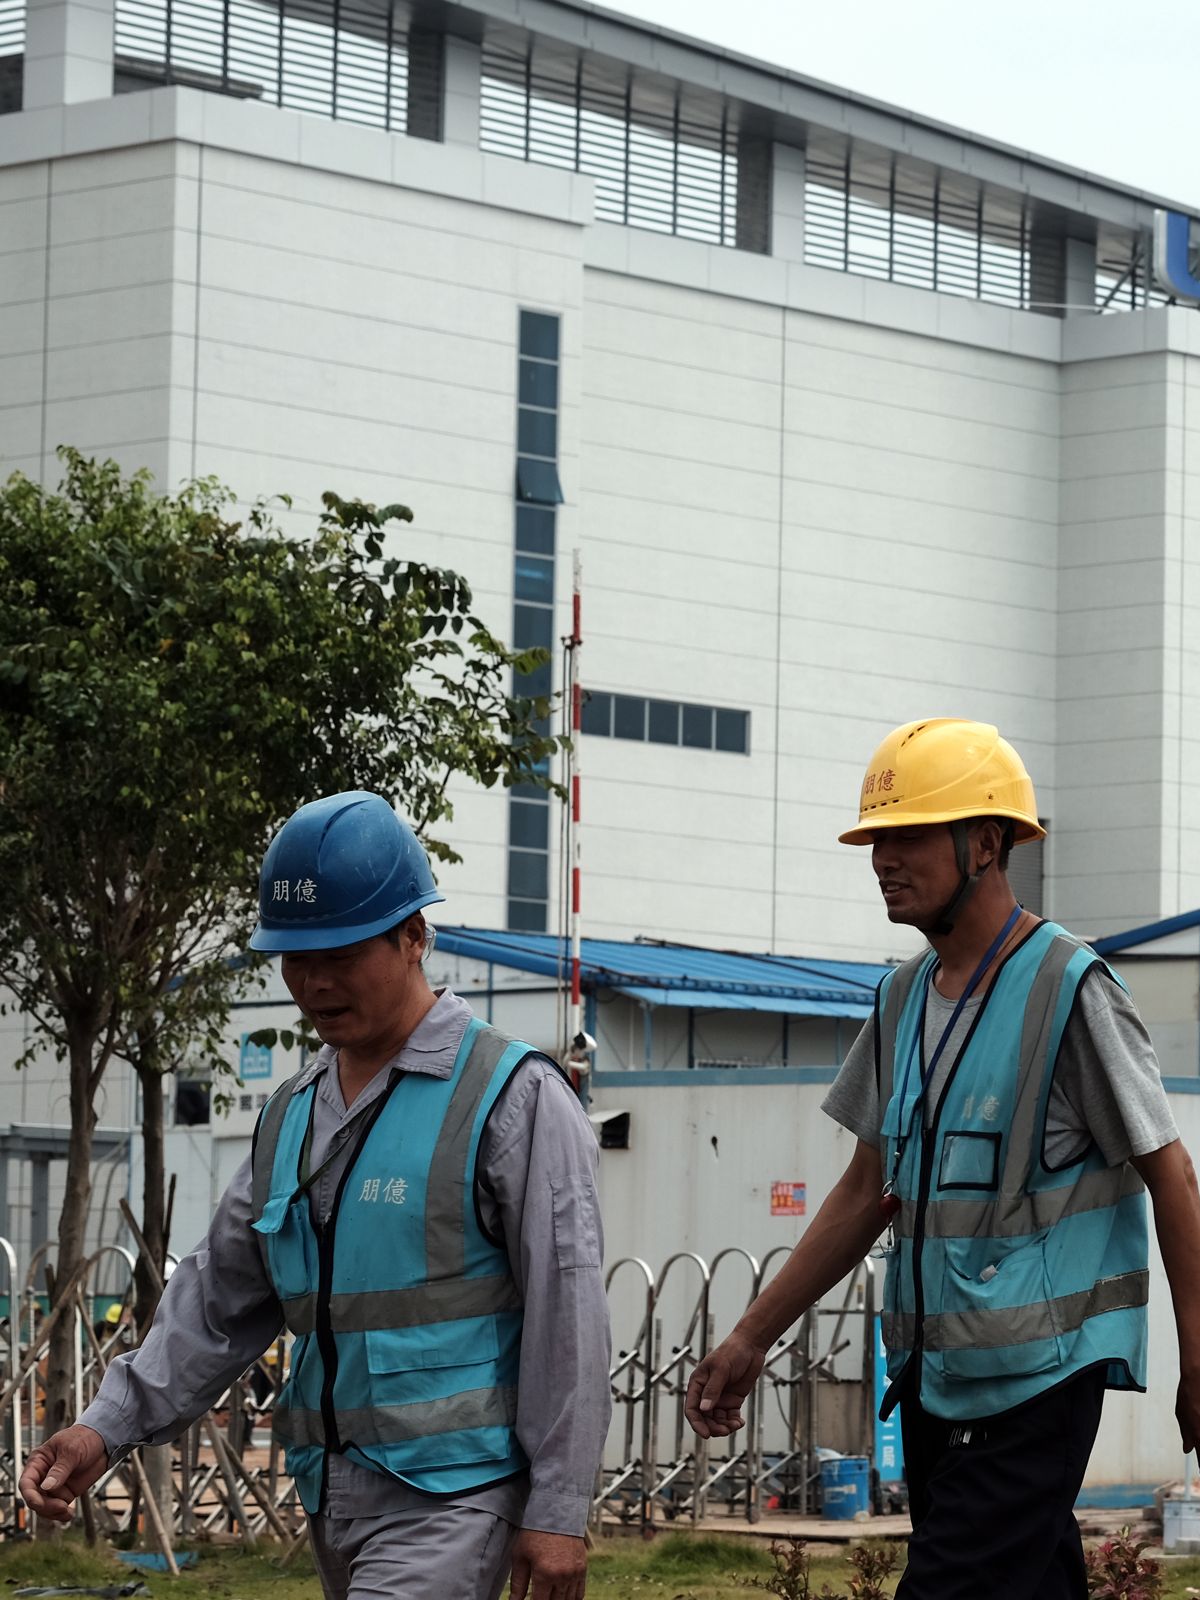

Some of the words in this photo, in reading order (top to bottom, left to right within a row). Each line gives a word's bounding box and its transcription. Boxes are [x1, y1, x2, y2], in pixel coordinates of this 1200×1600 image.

[865, 768, 896, 795] 朋億
[272, 878, 317, 903] 朋億
[358, 1177, 408, 1205] 朋億
